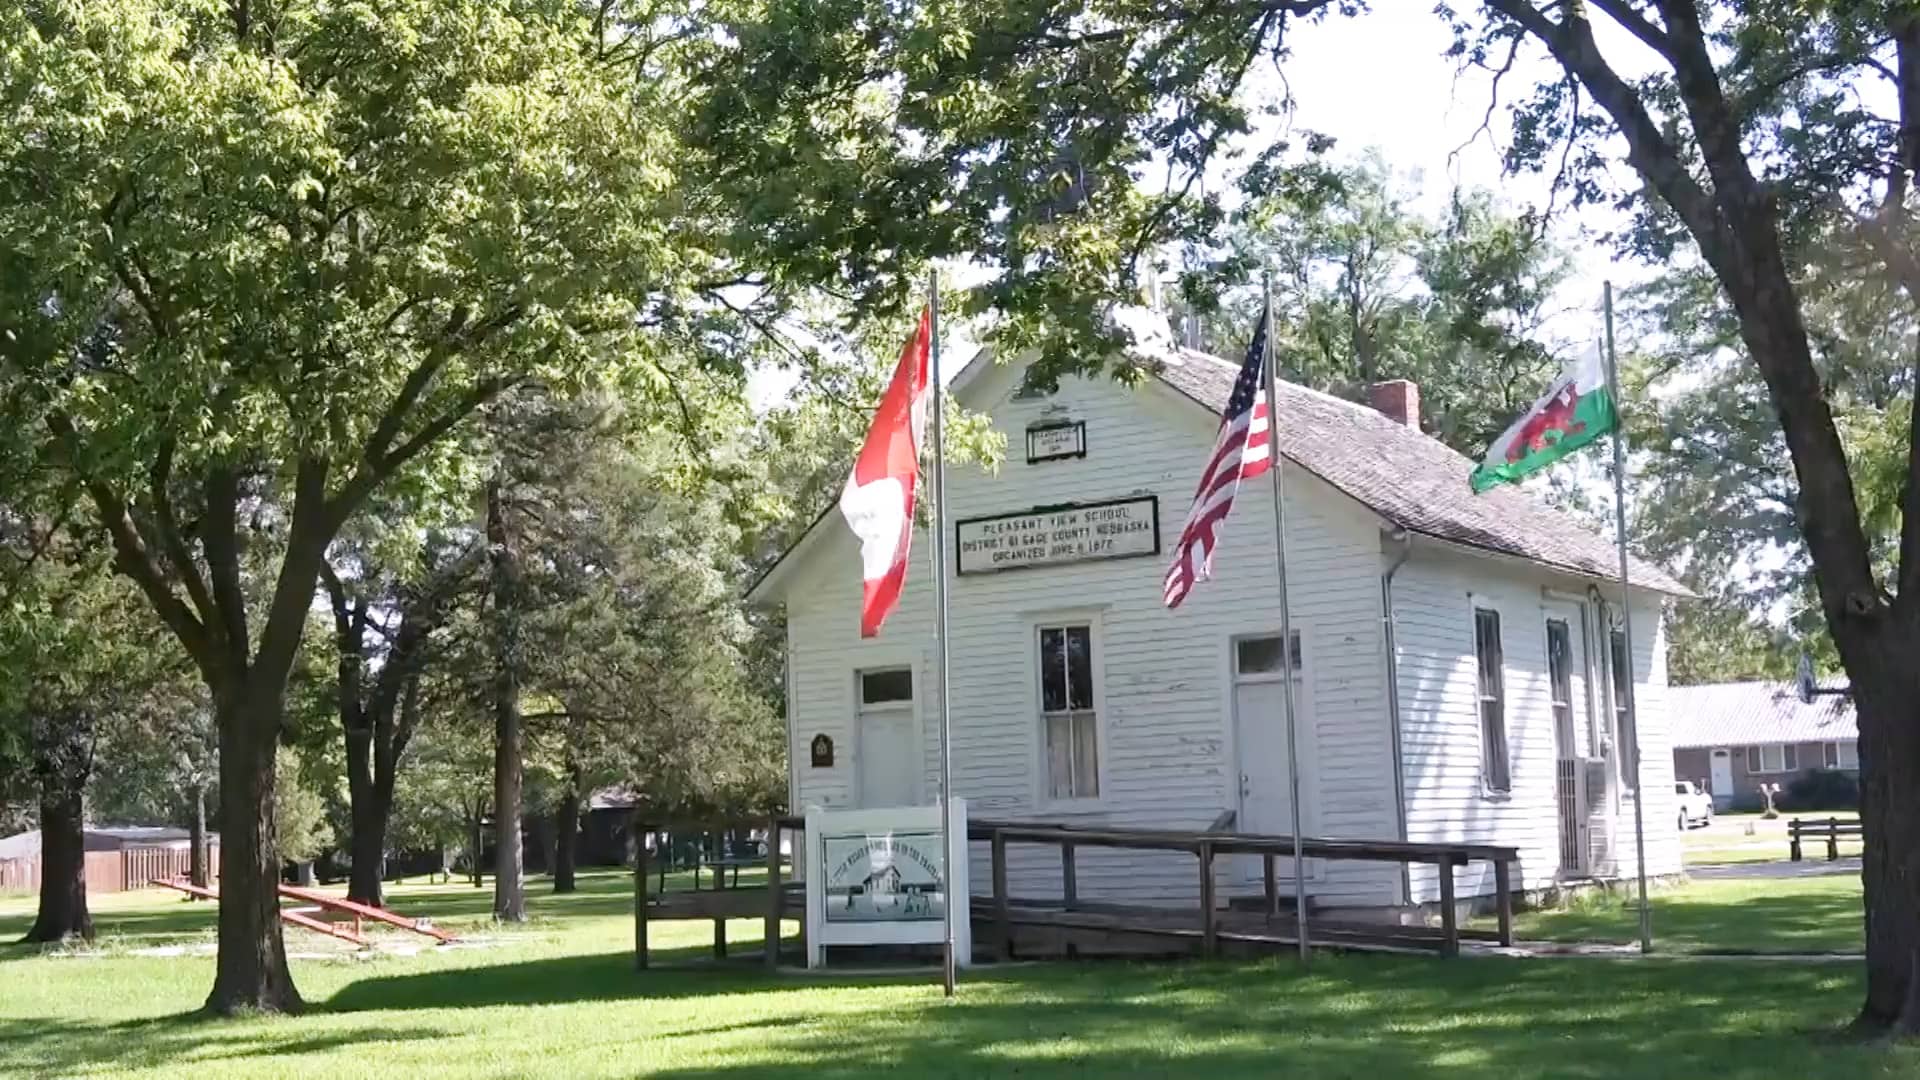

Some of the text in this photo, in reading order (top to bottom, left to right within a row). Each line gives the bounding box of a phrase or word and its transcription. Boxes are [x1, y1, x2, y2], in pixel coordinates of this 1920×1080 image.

[962, 538, 1004, 553] DISTRICT
[1052, 527, 1090, 542] COUNTY
[1096, 519, 1149, 535] NEBRASKA
[983, 507, 1129, 536] PLEASANT VIEW SCHOOL
[992, 548, 1046, 562] ORGANIZED
